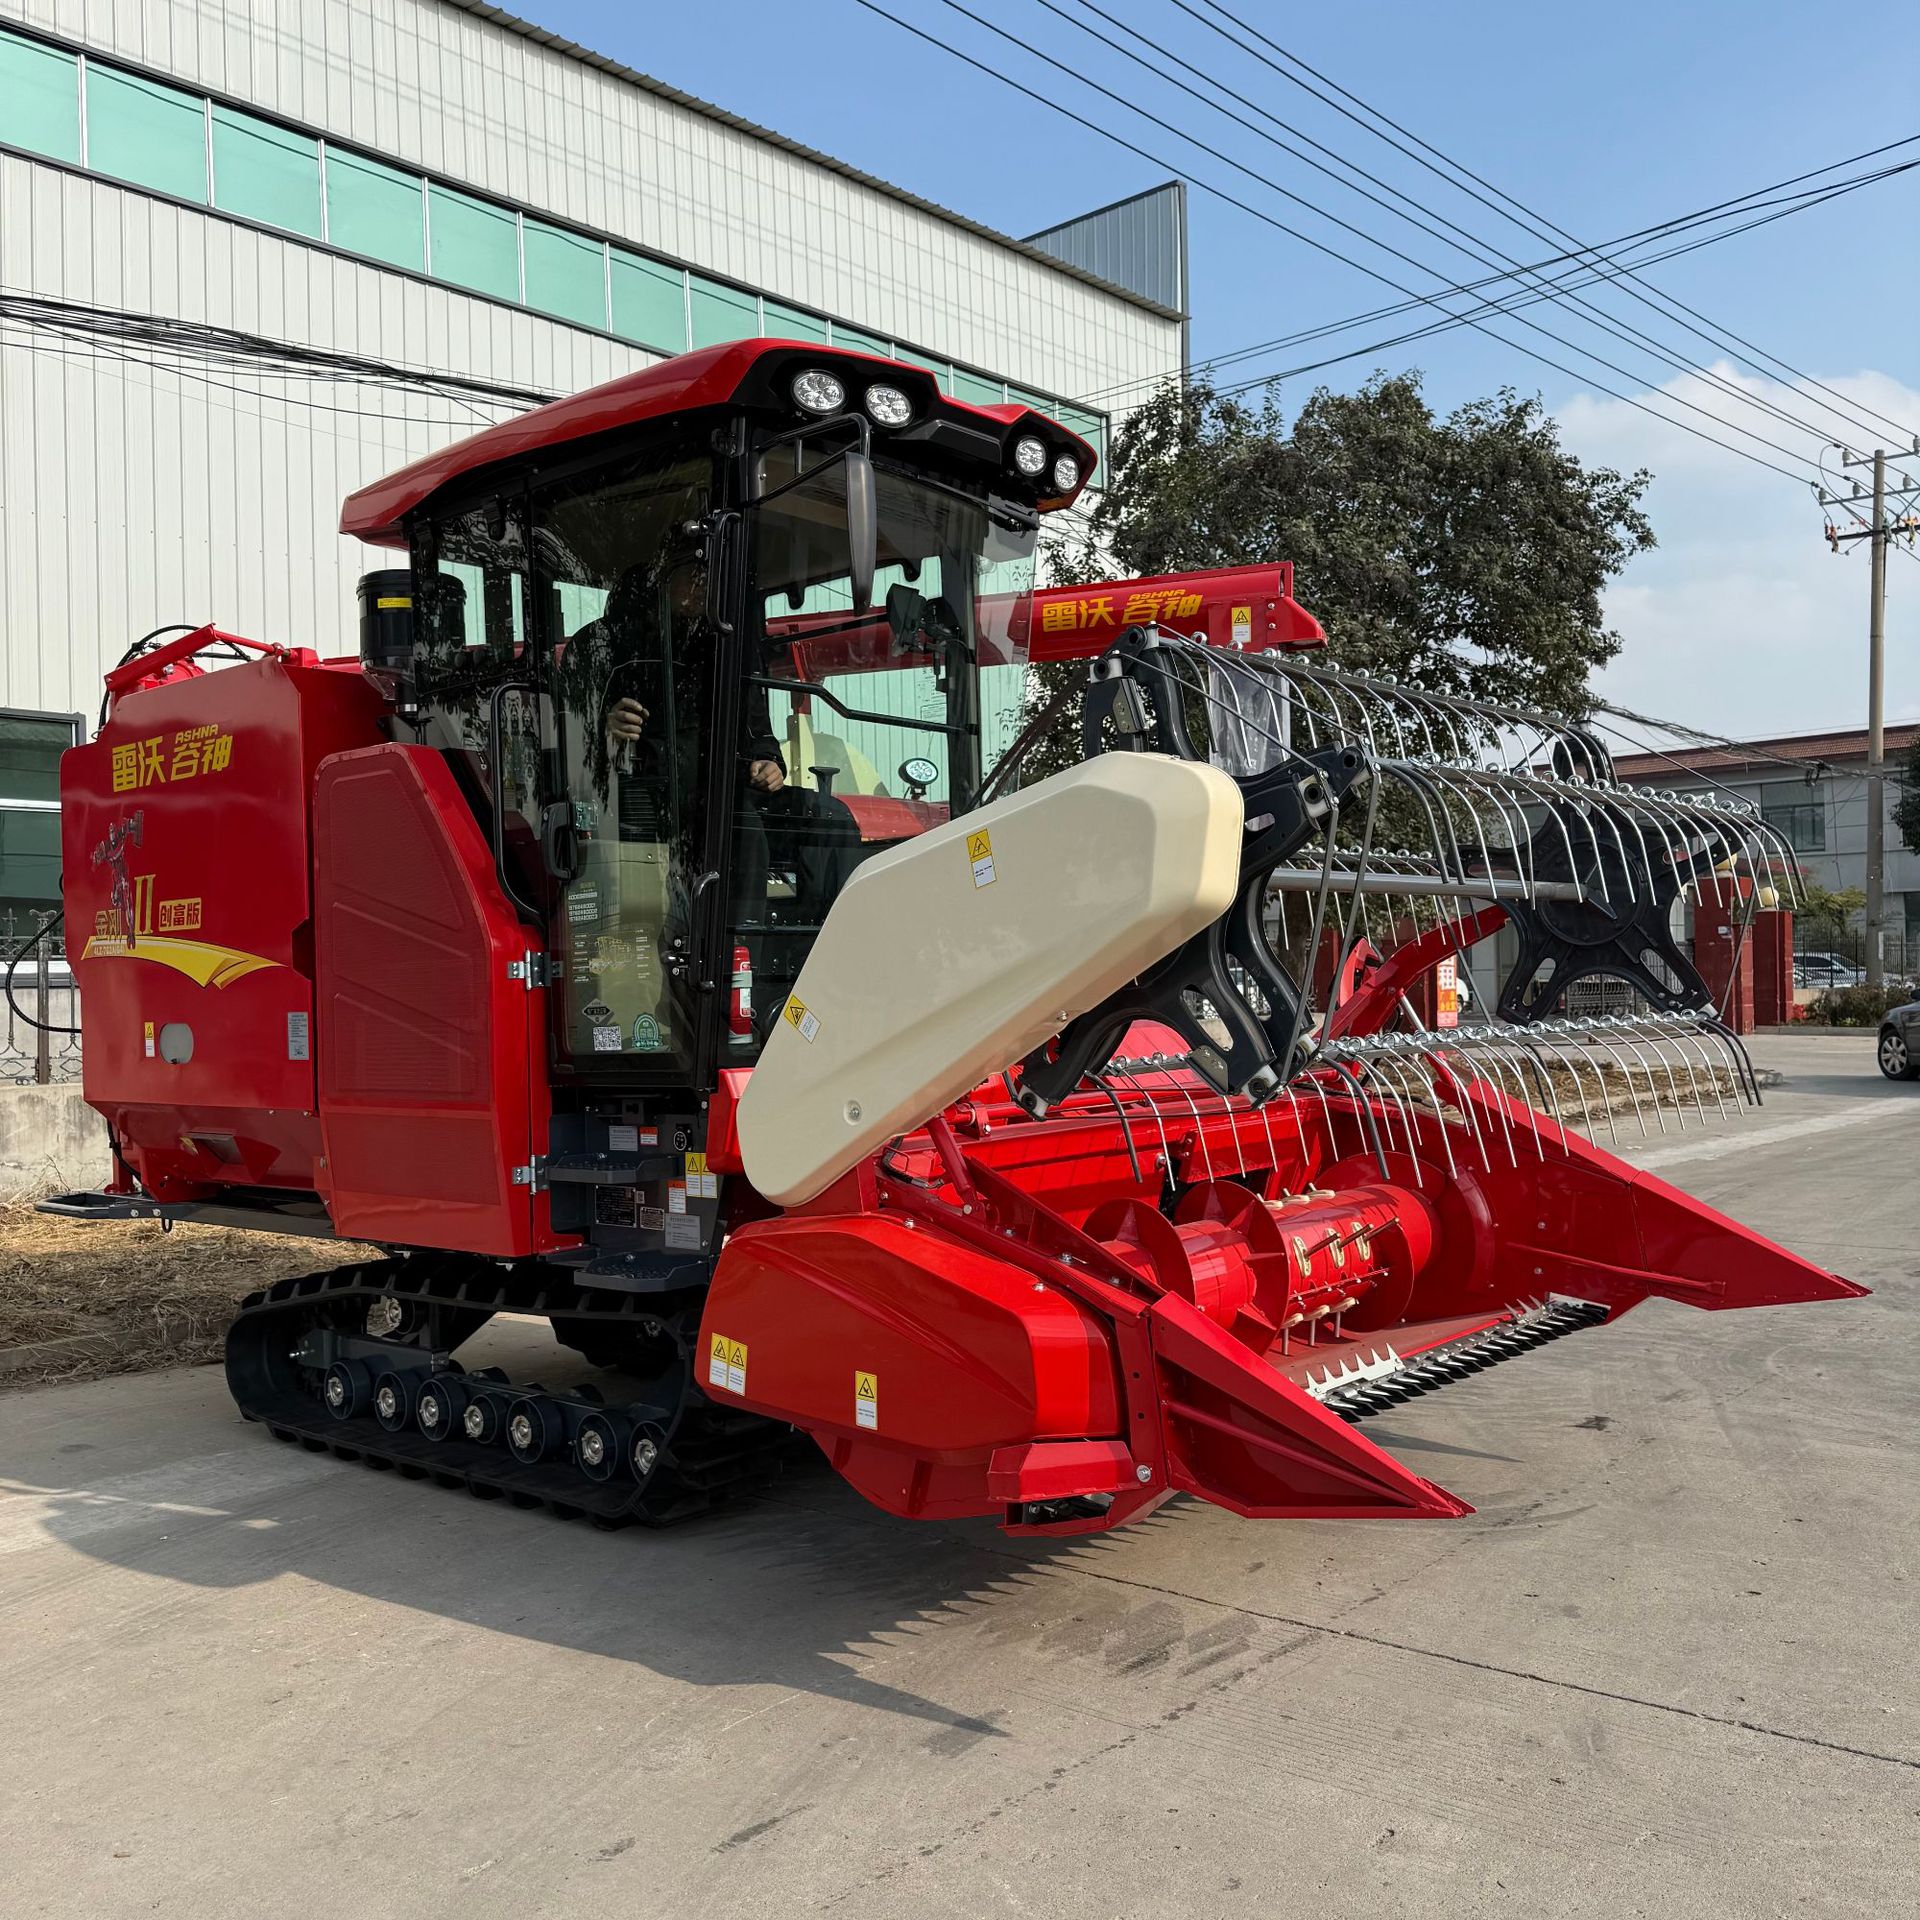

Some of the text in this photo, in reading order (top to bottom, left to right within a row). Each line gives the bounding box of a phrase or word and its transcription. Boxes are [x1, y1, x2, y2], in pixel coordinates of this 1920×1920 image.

[1129, 589, 1187, 600] ASHNA
[174, 723, 219, 745] ASHNA
[160, 901, 200, 928] 创富版
